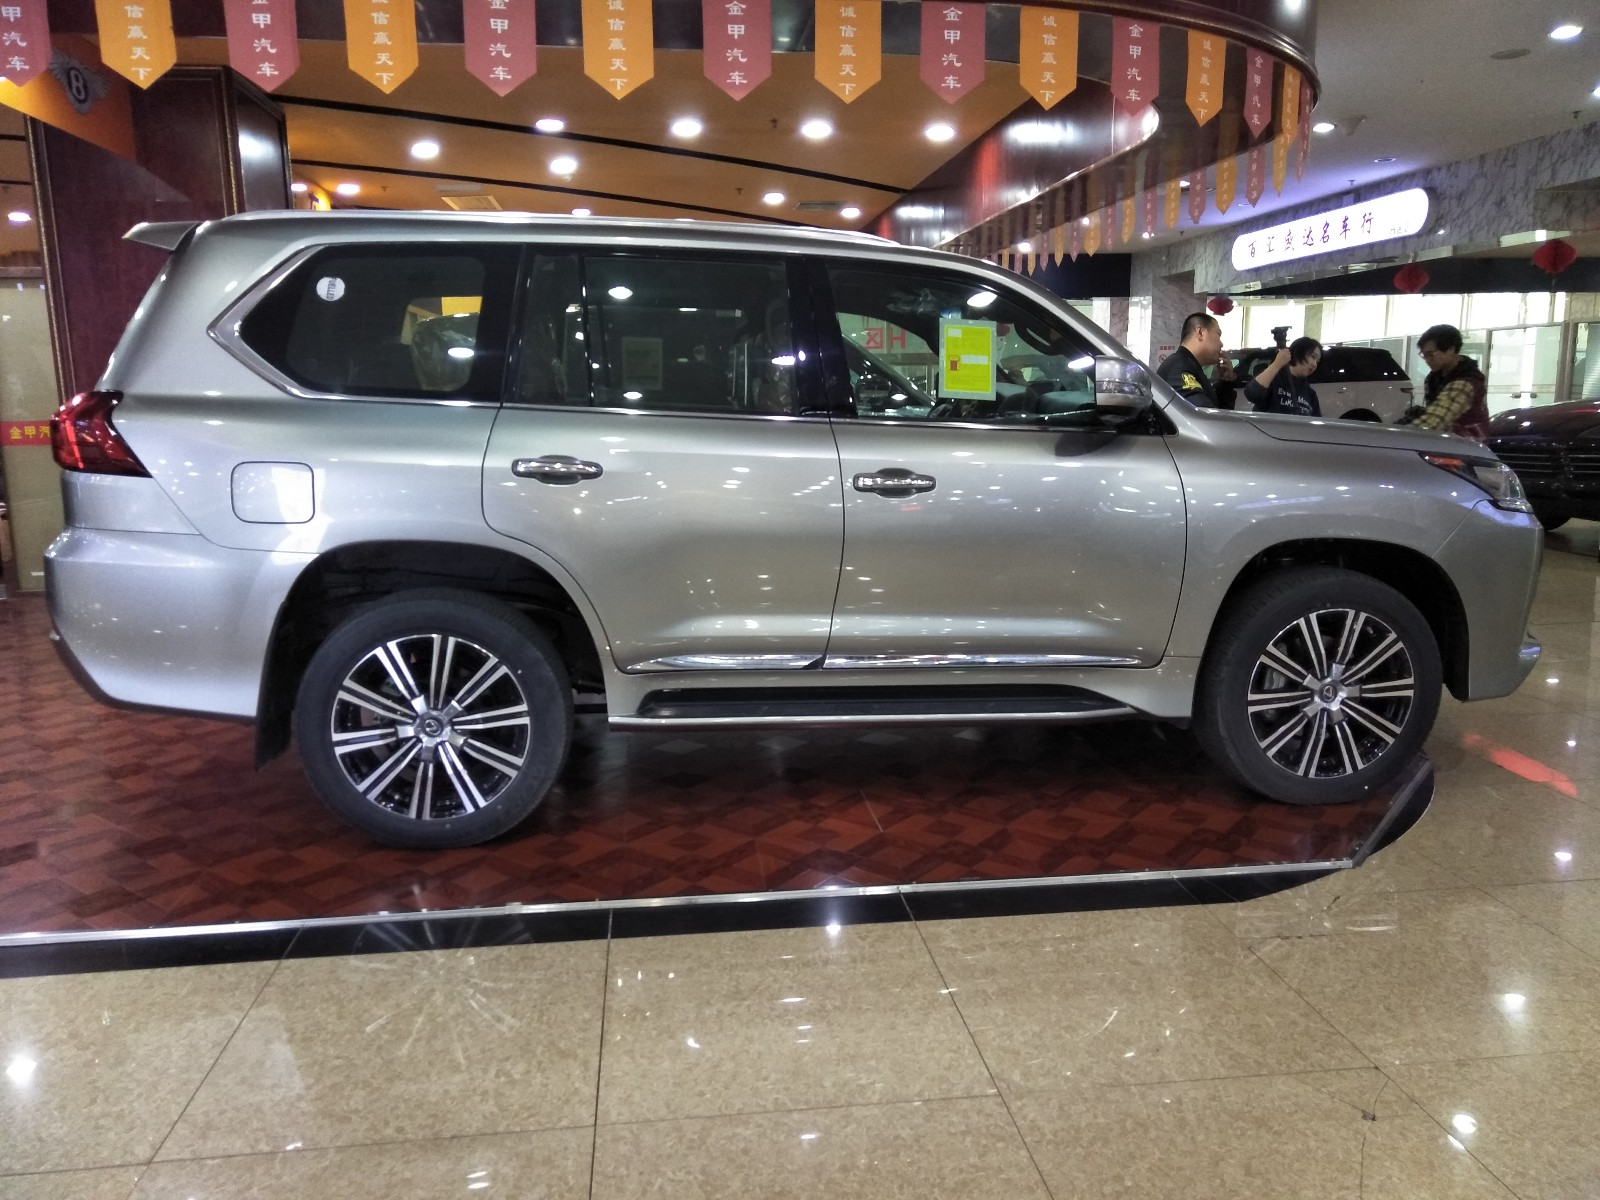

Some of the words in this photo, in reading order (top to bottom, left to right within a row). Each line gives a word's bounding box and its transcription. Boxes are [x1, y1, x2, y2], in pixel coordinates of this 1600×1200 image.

[1, 5, 30, 71] 甲汽车
[251, 0, 279, 77] 甲汽车
[371, 0, 395, 85] 信赢天下
[725, 1, 747, 86] 金甲汽车
[839, 6, 857, 95] 诚信赢天下
[942, 7, 962, 90] 金甲汽车
[1126, 24, 1144, 102] 金甲汽车
